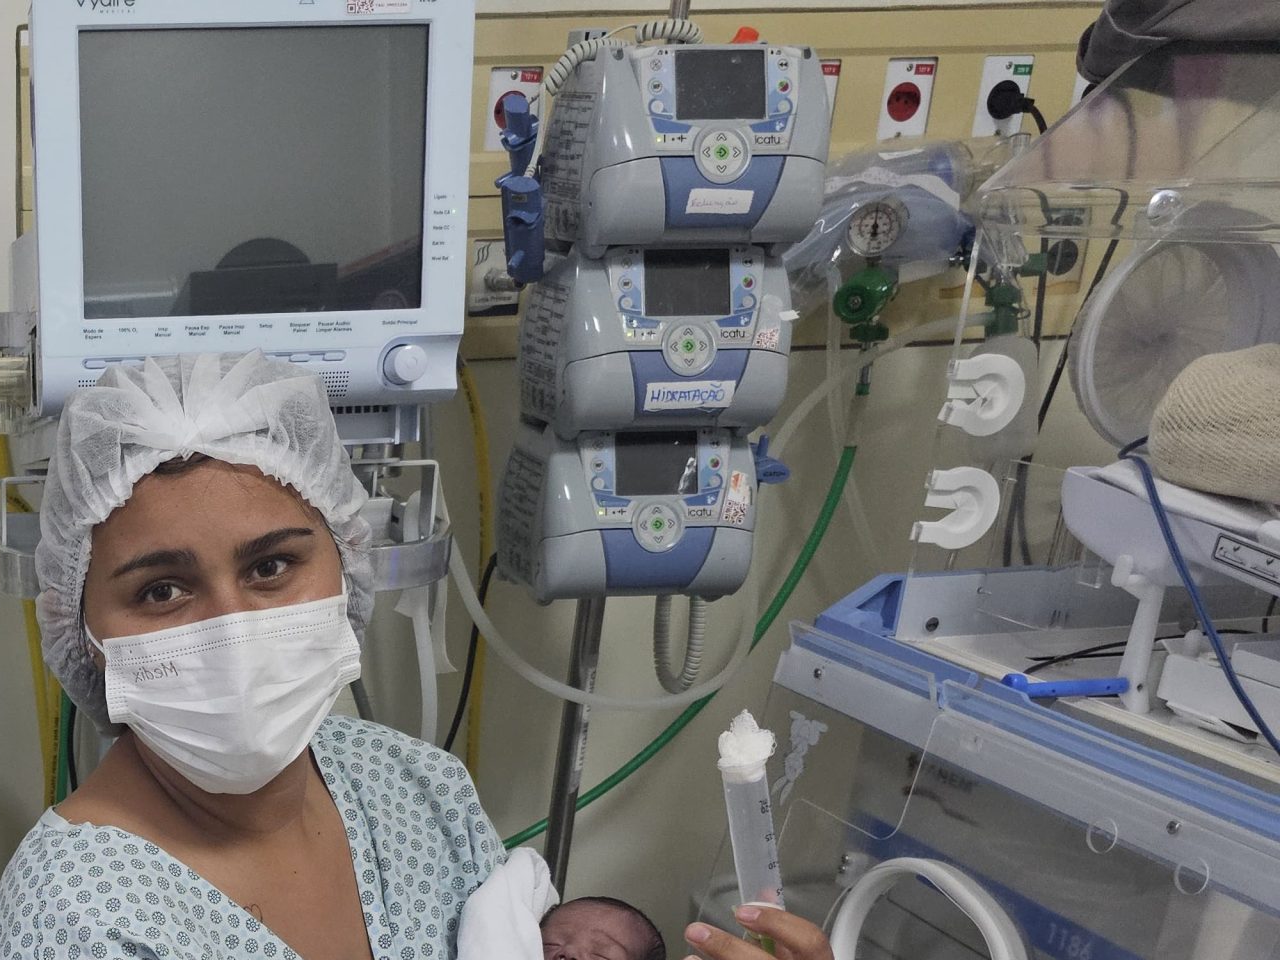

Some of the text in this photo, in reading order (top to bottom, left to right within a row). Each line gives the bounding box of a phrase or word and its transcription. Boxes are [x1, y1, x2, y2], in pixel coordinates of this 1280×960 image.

[754, 134, 781, 146] icatu
[719, 328, 746, 339] icatu
[687, 507, 712, 517] icatu
